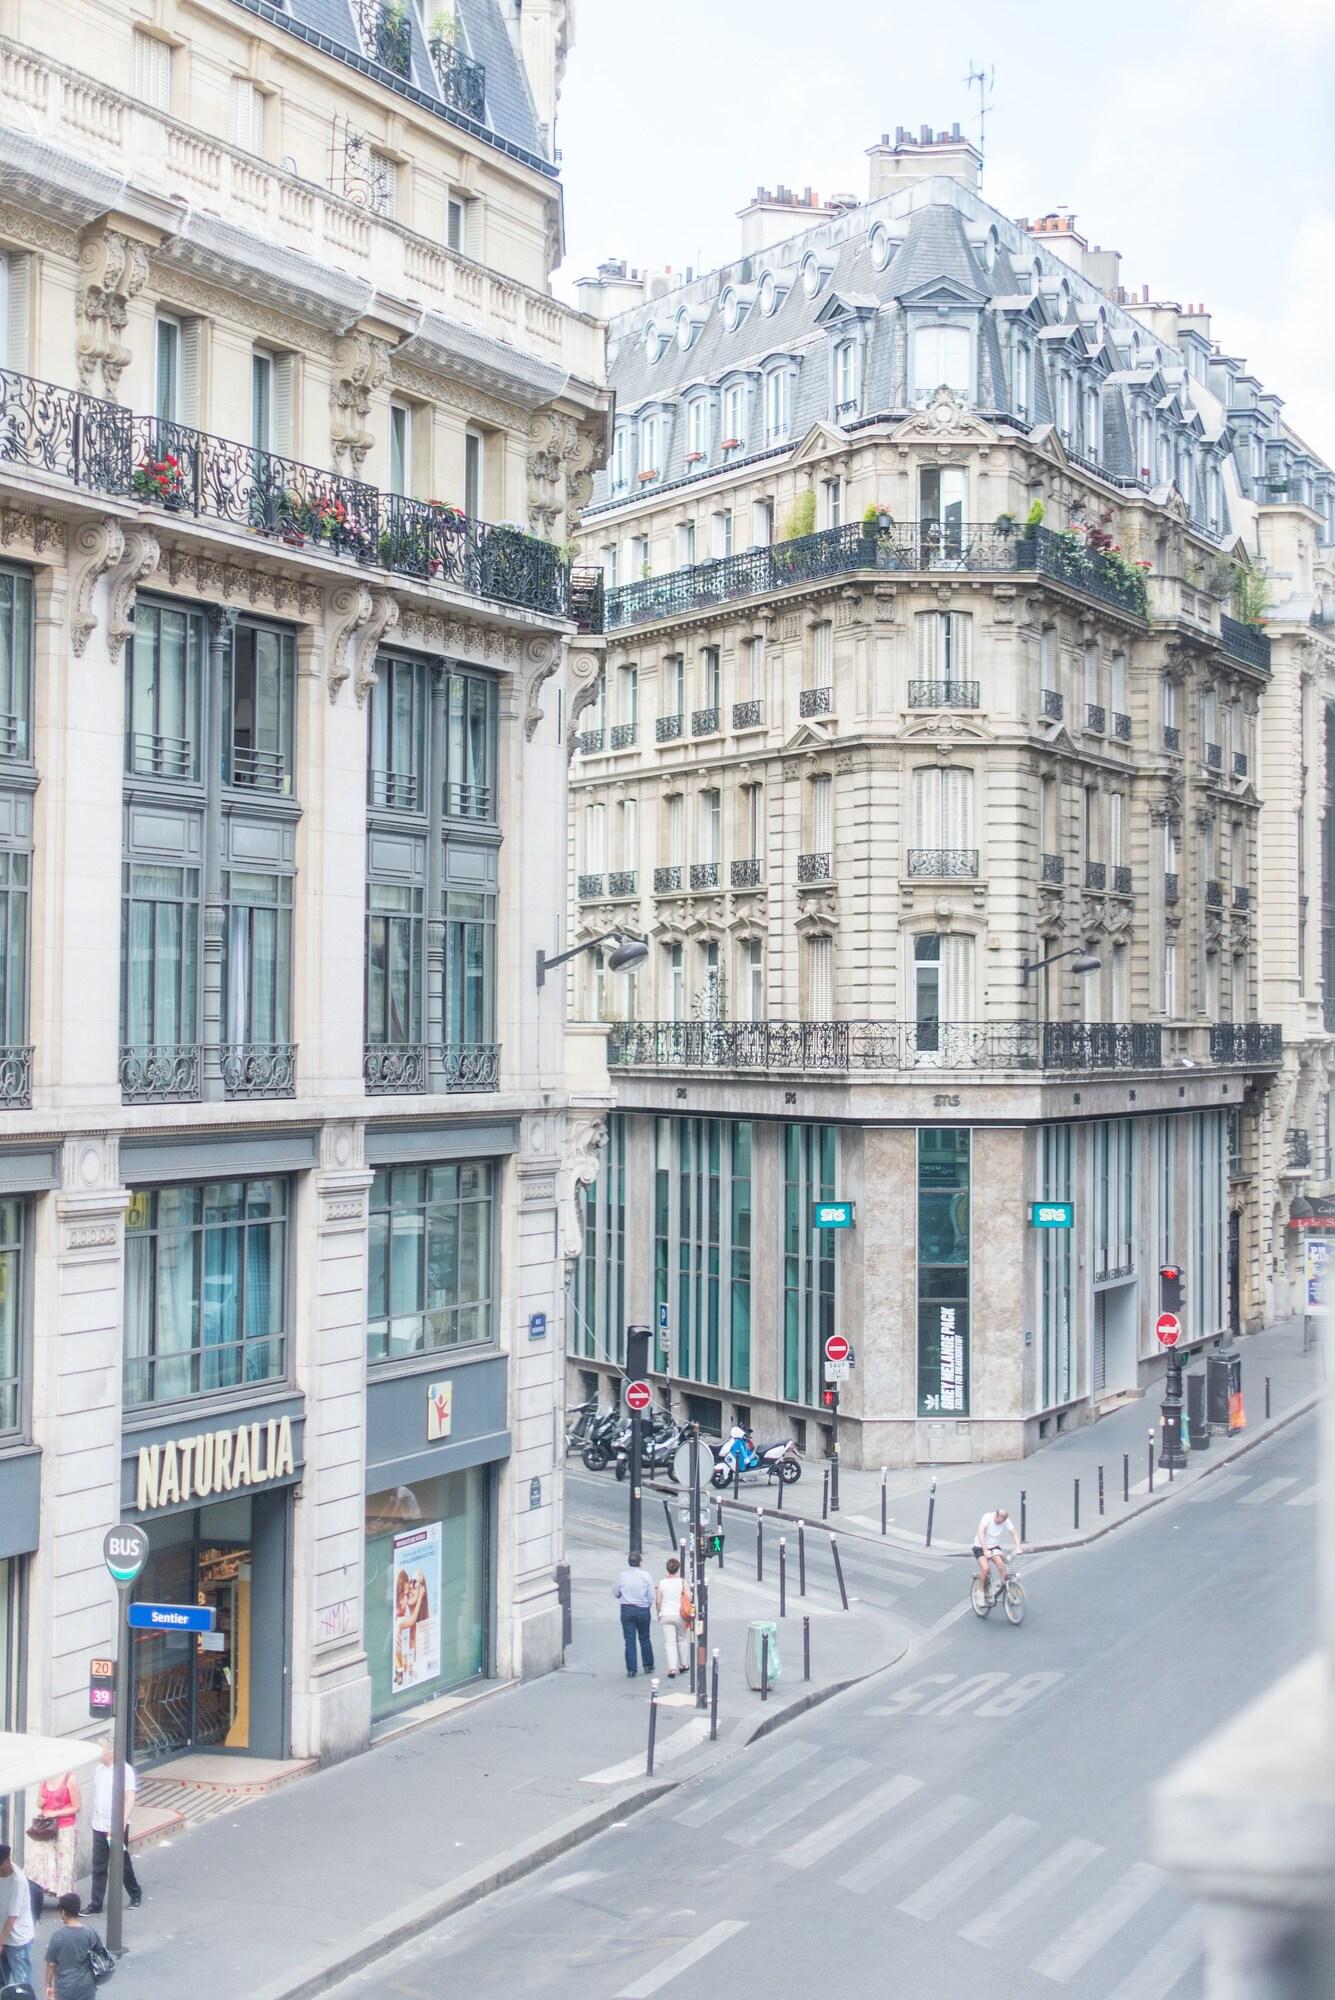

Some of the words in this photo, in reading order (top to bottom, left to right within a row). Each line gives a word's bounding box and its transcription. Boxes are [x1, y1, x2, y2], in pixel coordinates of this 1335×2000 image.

[940, 1306, 955, 1335] PACK
[940, 1334, 955, 1382] MELANGE
[940, 1381, 955, 1410] GREY
[137, 1415, 294, 1512] NATURALIA
[109, 1537, 140, 1556] BUS
[151, 1611, 190, 1625] Sentier
[94, 1662, 109, 1675] 20
[92, 1689, 109, 1704] 39
